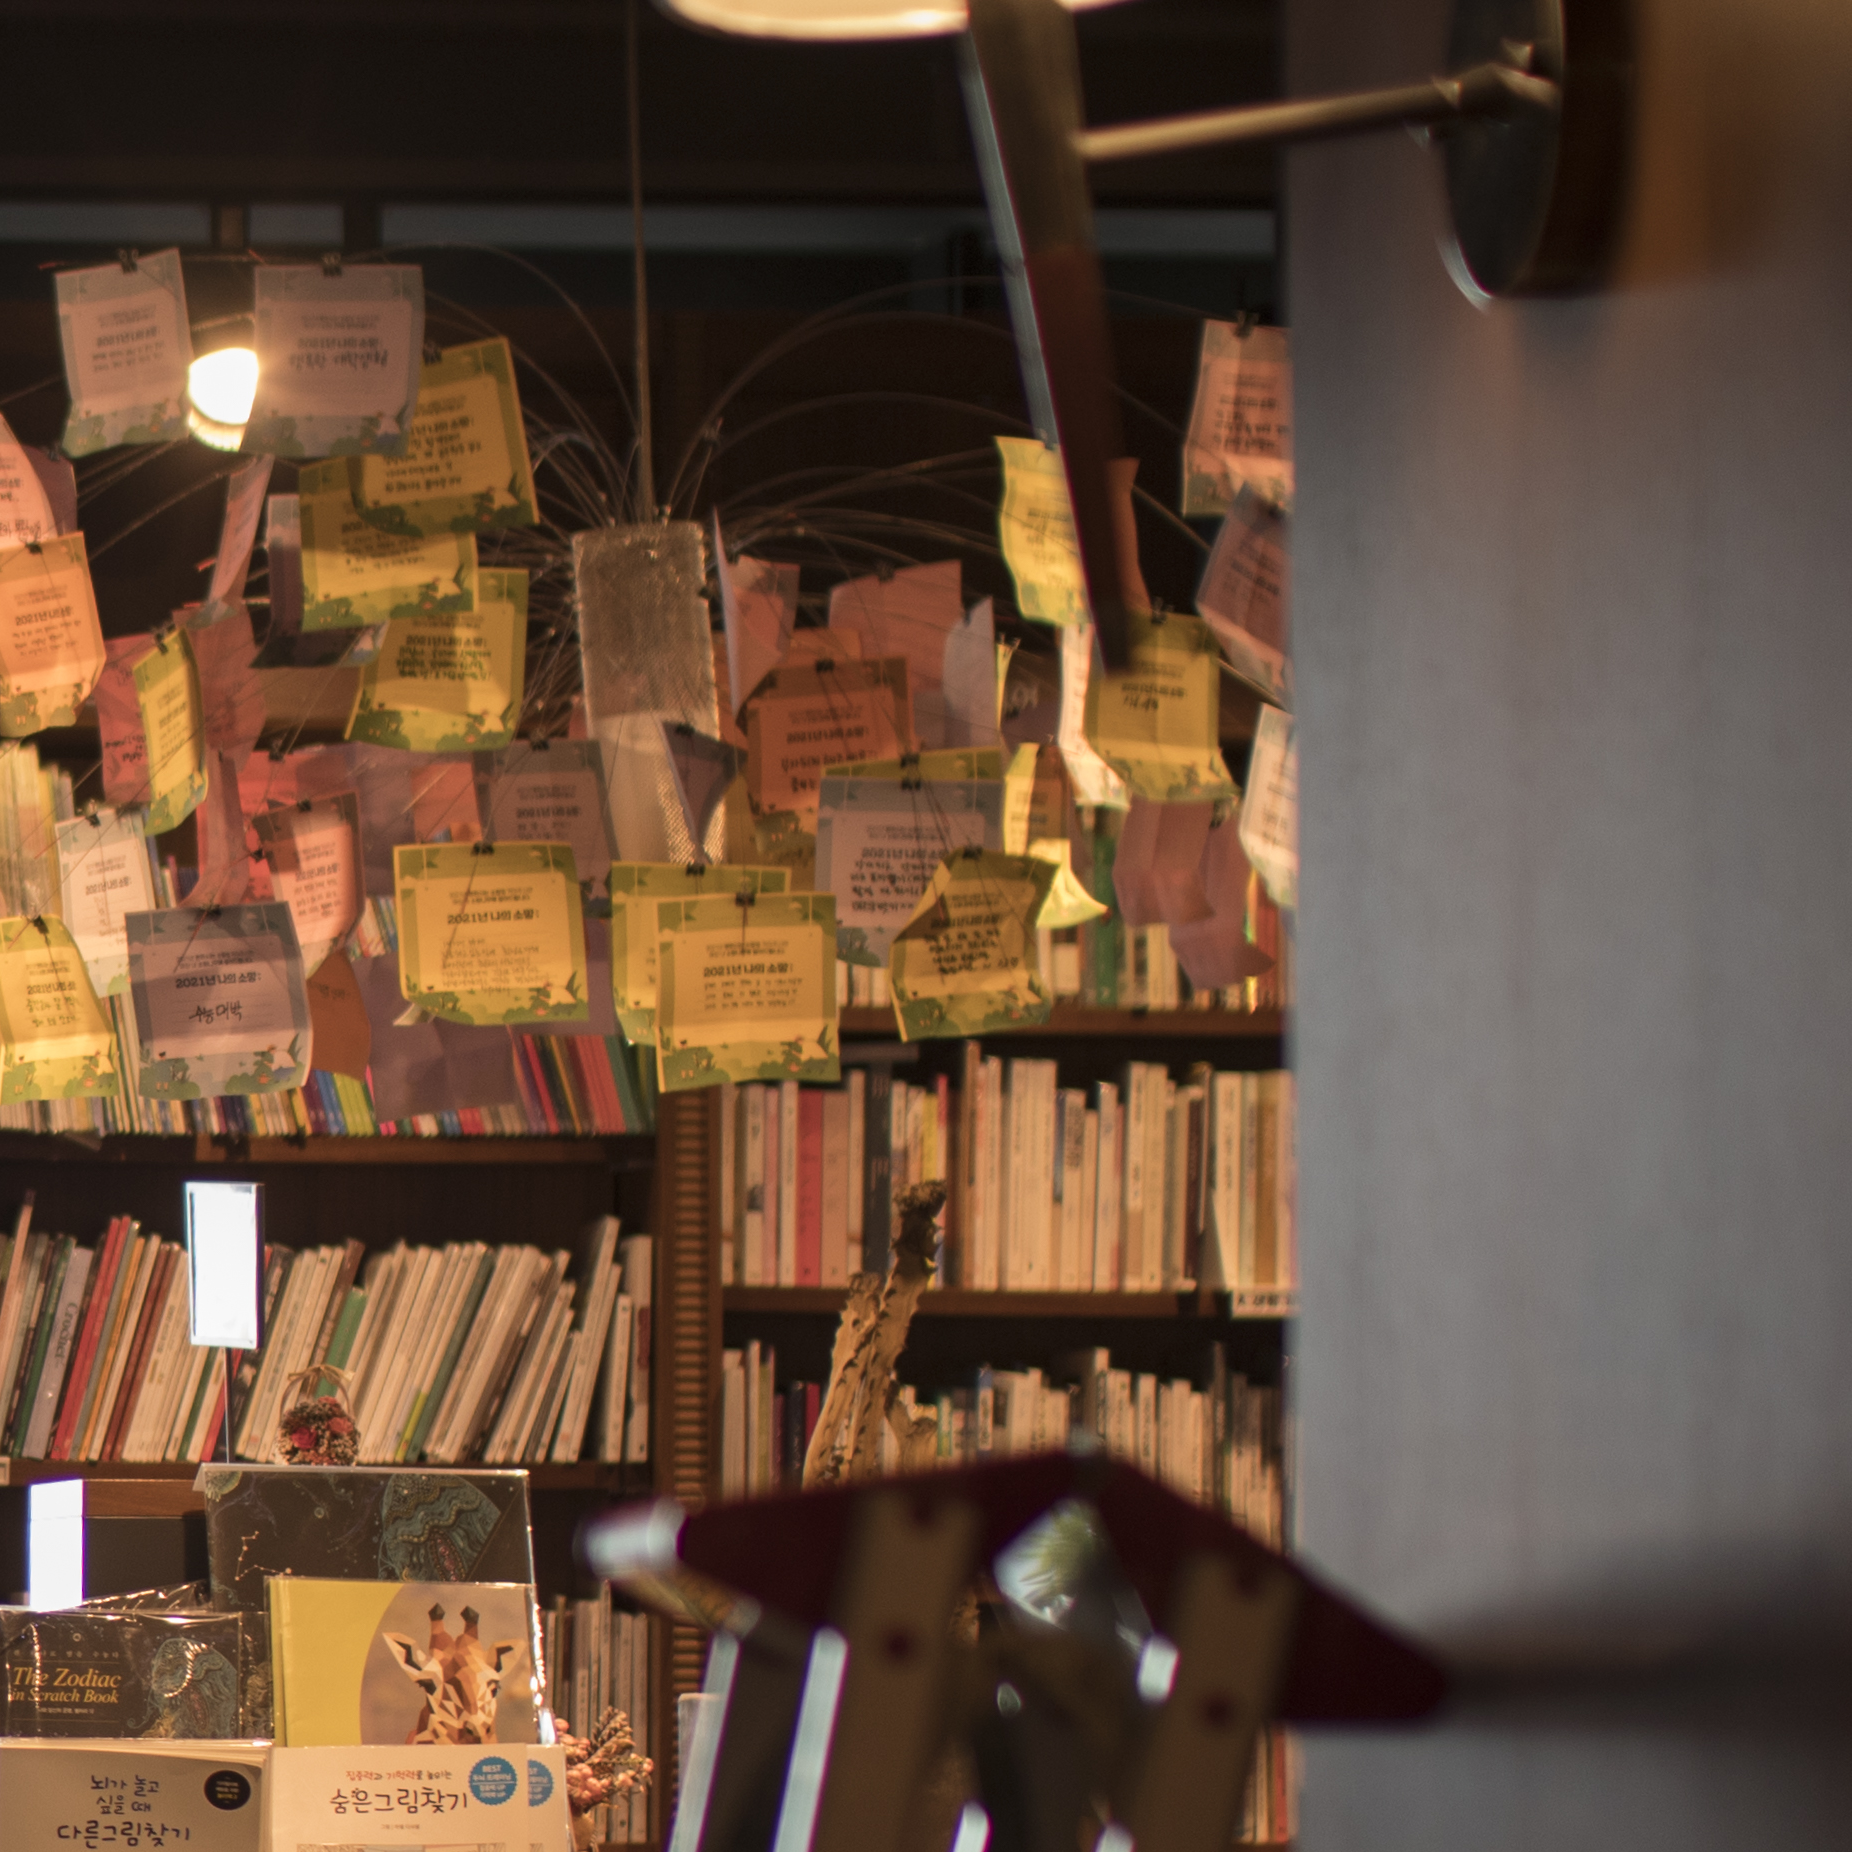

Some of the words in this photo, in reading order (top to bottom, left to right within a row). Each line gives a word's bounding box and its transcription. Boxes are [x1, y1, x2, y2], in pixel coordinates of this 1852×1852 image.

[447, 912, 488, 925] 2021년
[175, 974, 215, 989] 2021년
[216, 973, 236, 984] 나의
[238, 971, 262, 983] 소망:
[13, 1667, 49, 1686] The
[53, 1667, 122, 1688] Zodiac
[27, 1688, 80, 1702] Scratch
[83, 1688, 119, 1703] Book
[346, 1770, 383, 1782] 집중력과
[426, 1770, 453, 1780] 높이는
[482, 1765, 502, 1773] BEST
[91, 1775, 128, 1790] 뇌가
[134, 1774, 160, 1797] 놀고
[96, 1795, 126, 1815] 싶을
[131, 1801, 152, 1812] 때
[330, 1786, 468, 1815] 숨은그림찾기
[57, 1820, 191, 1849] 다른그림찾기
